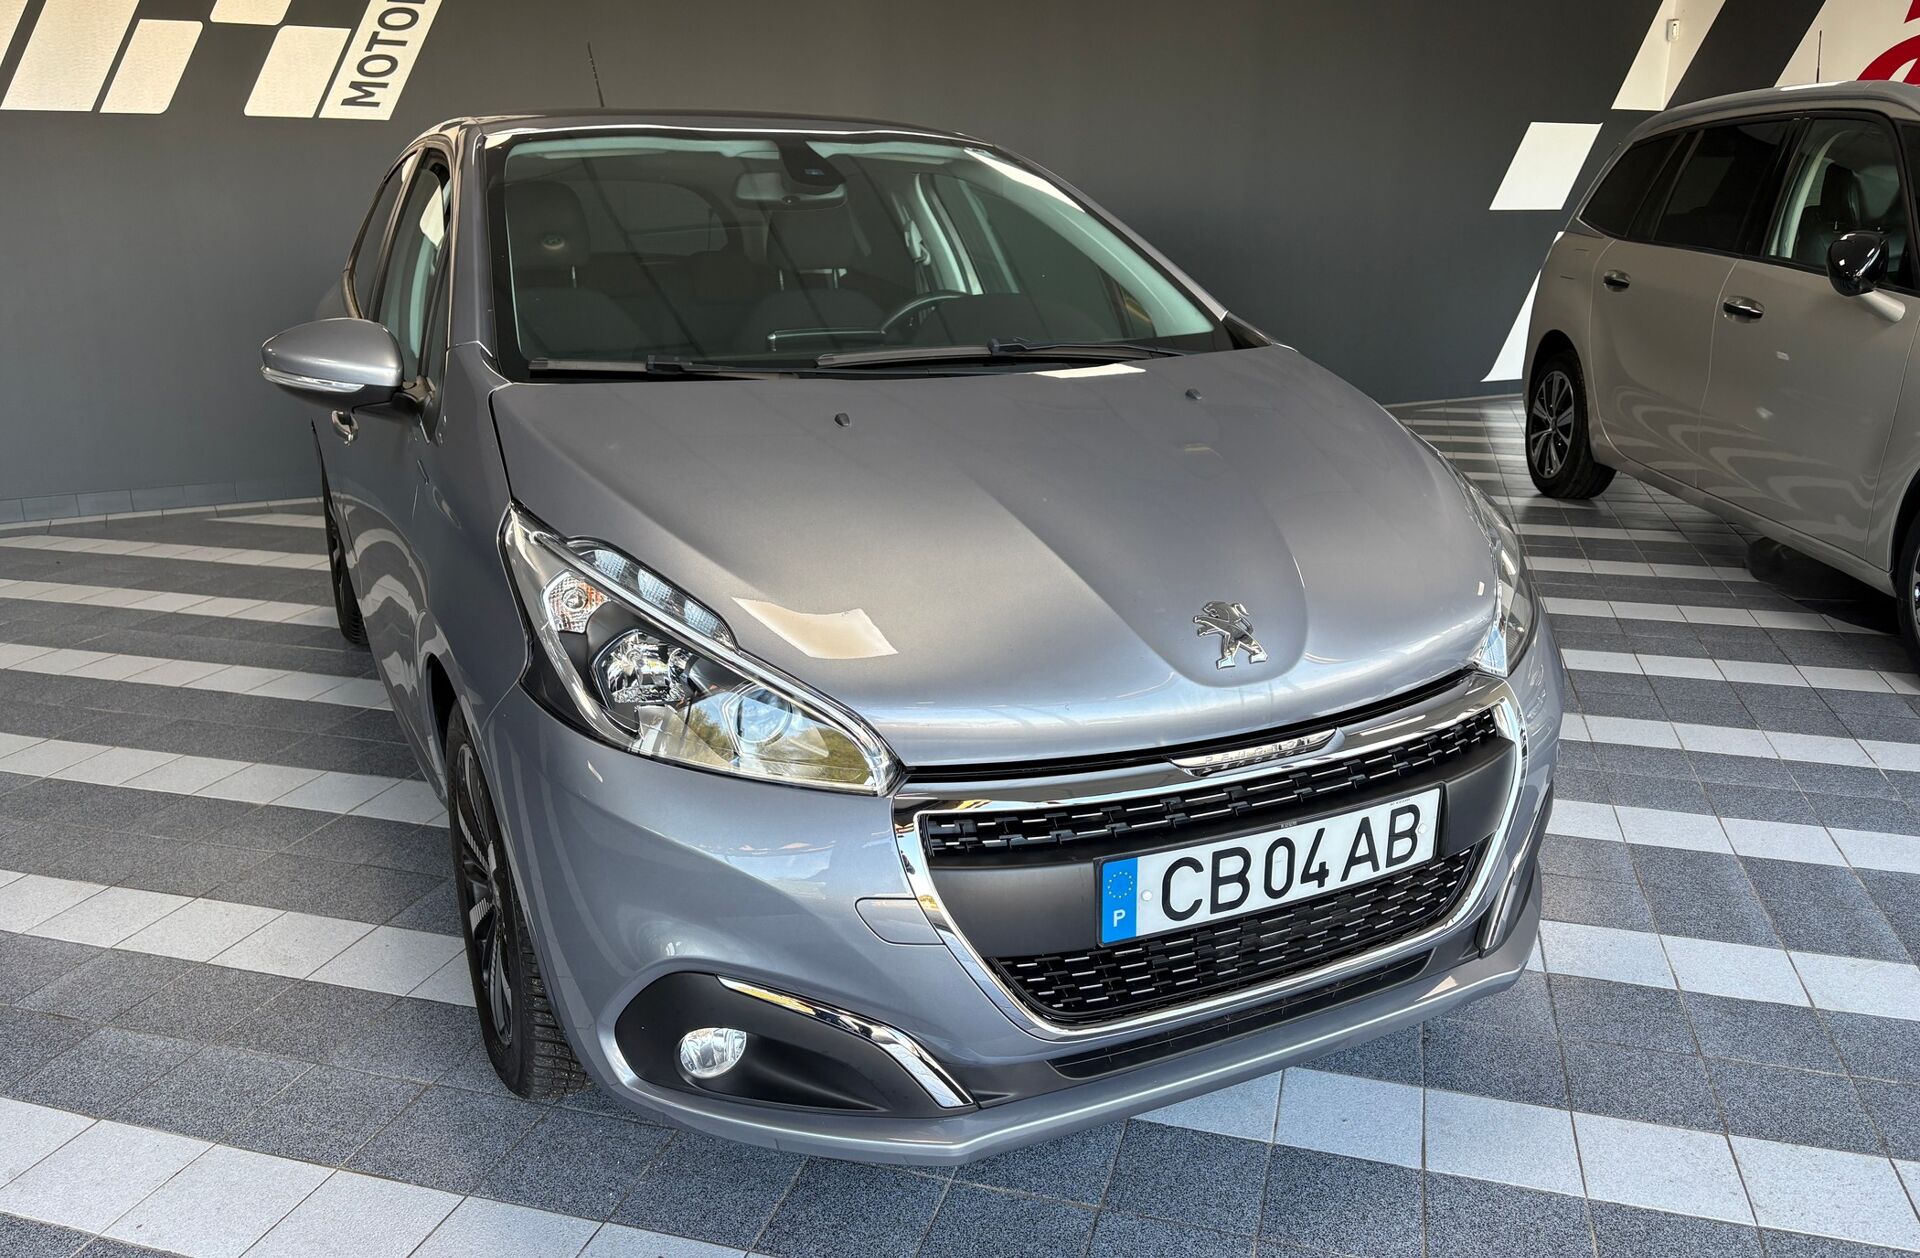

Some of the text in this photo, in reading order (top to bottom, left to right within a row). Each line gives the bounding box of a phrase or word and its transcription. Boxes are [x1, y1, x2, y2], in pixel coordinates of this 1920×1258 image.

[341, 0, 426, 108] MOTO
[1161, 804, 1421, 922] CB 04 AB
[1113, 909, 1126, 928] P
